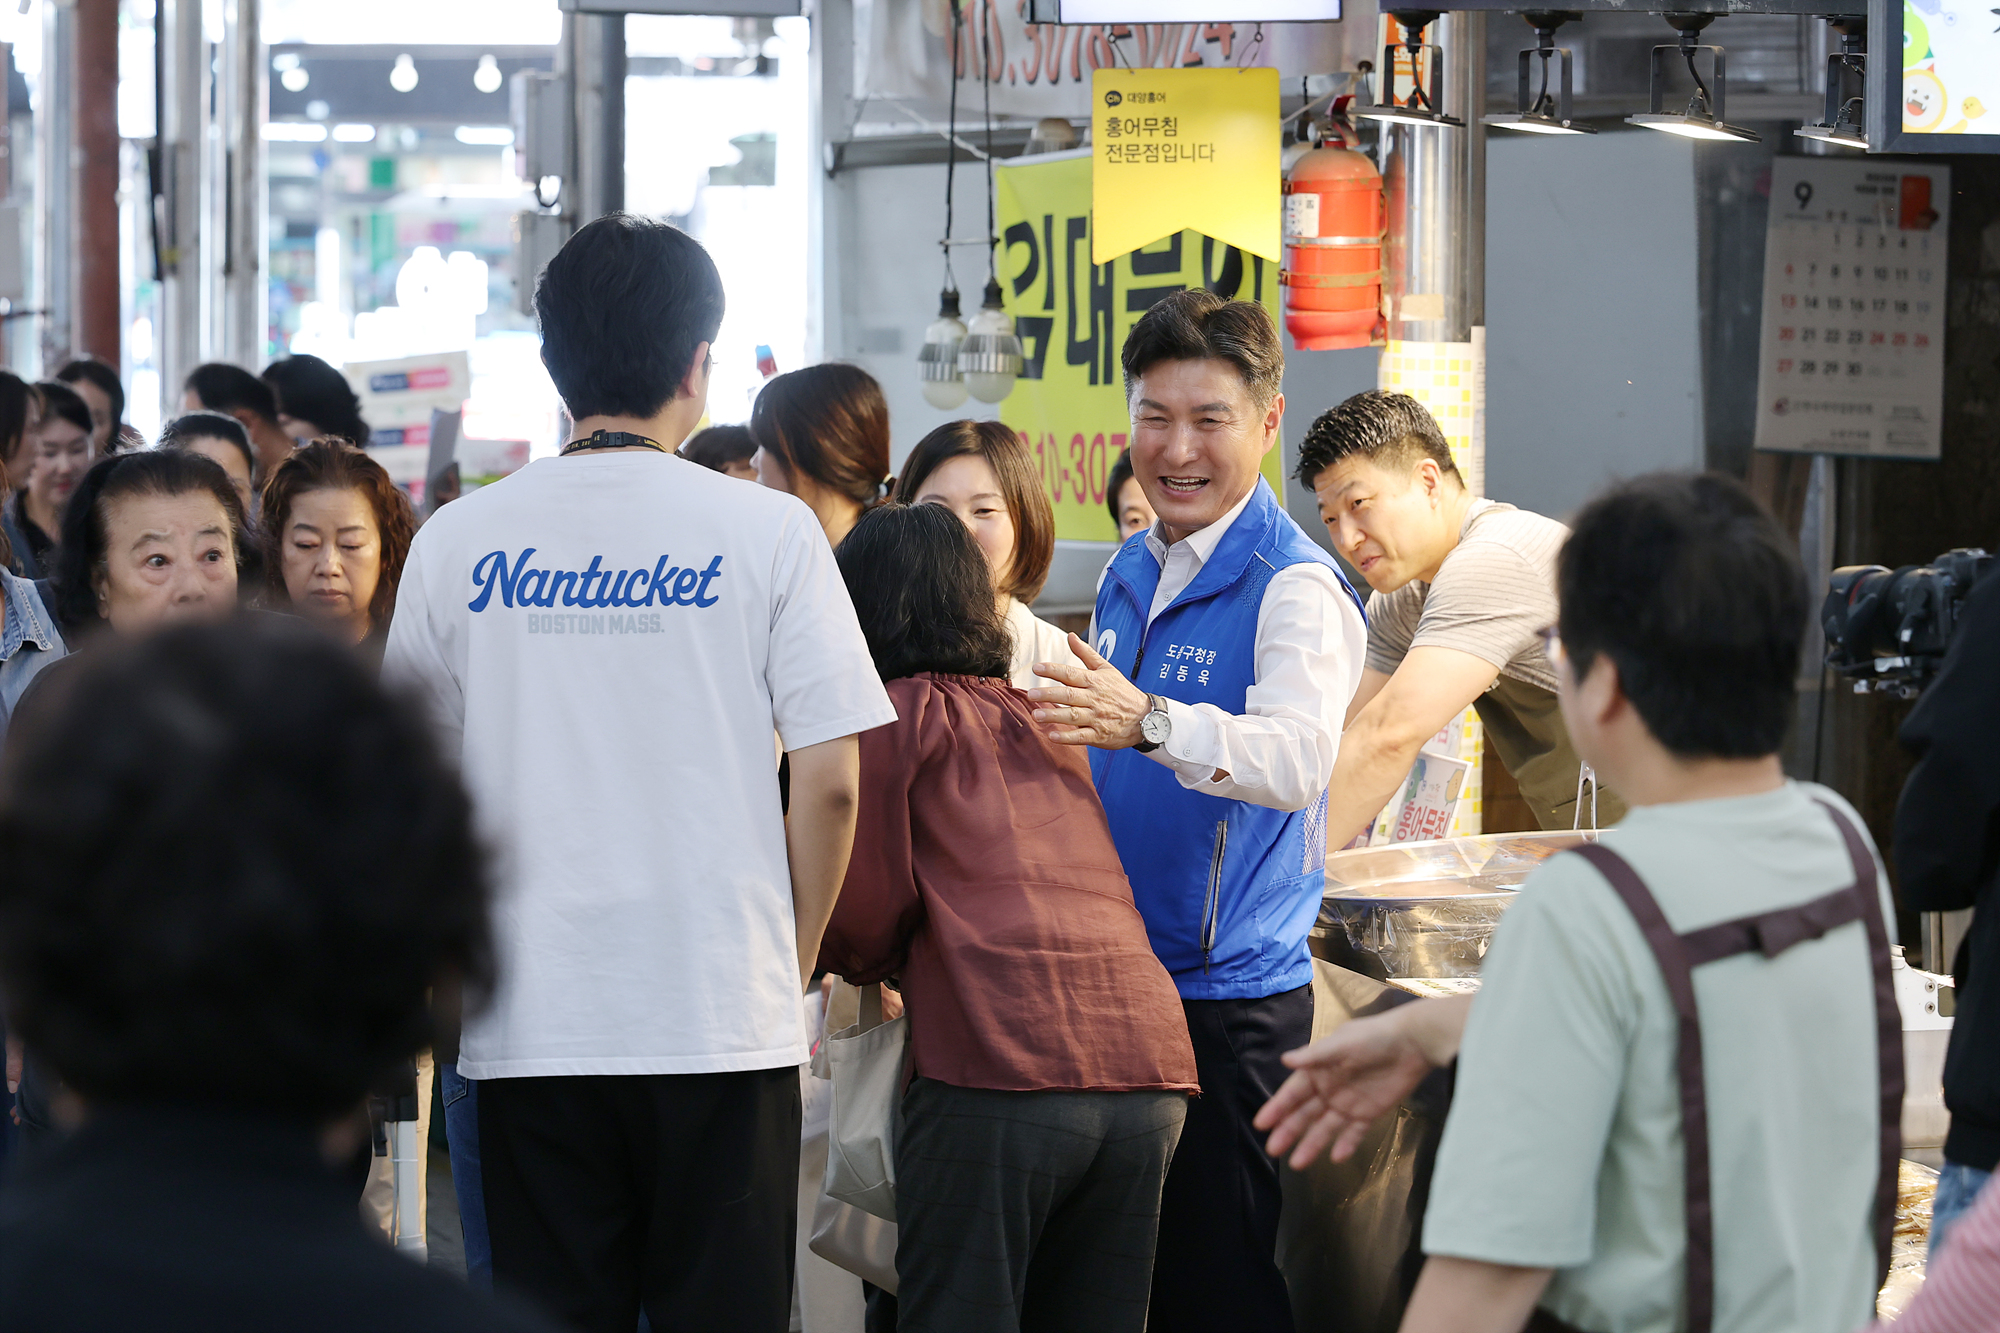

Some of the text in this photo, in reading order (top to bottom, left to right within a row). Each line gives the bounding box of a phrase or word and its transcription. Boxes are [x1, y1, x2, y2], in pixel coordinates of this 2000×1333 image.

[1105, 117, 1178, 138] 홍어무침
[1105, 143, 1216, 164] 전문점입니다
[1794, 180, 1813, 211] 9
[1004, 205, 1263, 386] 임대
[1018, 431, 1128, 505] 10-30
[468, 548, 723, 613] Nantucket
[528, 613, 665, 635] BOSTON MASS.
